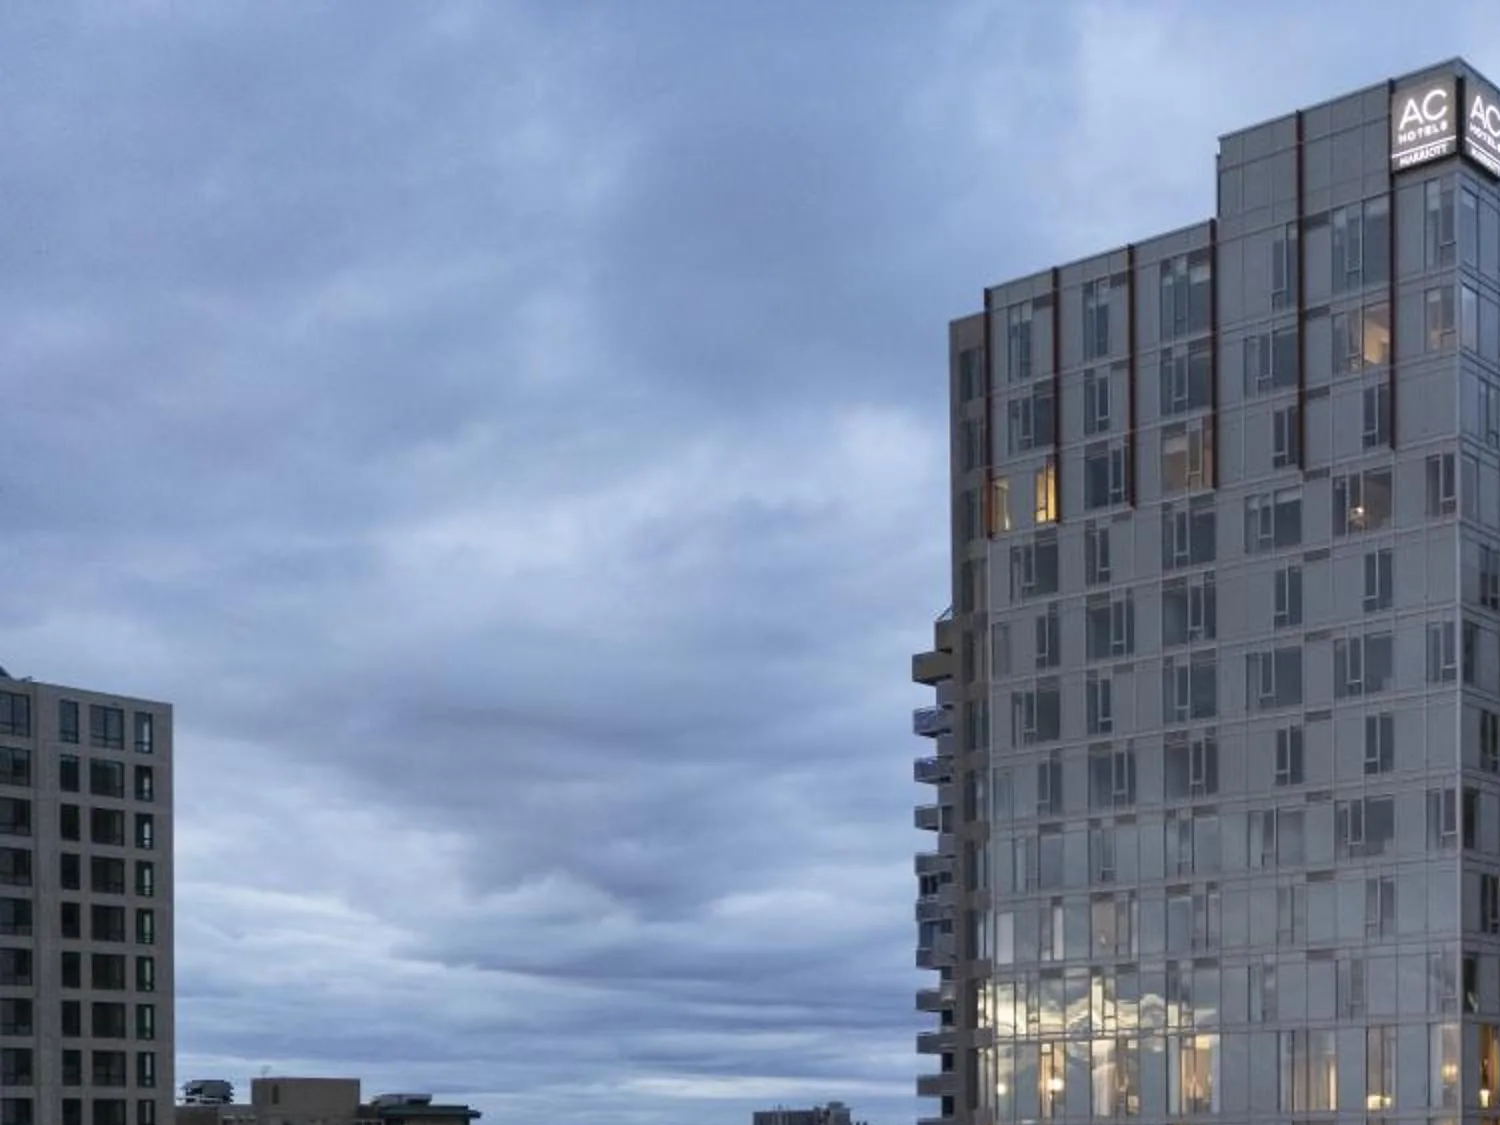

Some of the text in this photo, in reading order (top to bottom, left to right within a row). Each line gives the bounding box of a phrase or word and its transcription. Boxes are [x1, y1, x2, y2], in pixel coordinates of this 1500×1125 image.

[1398, 89, 1447, 131] AC
[1398, 120, 1448, 145] HOTELS
[1399, 143, 1447, 168] MARRIOTT
